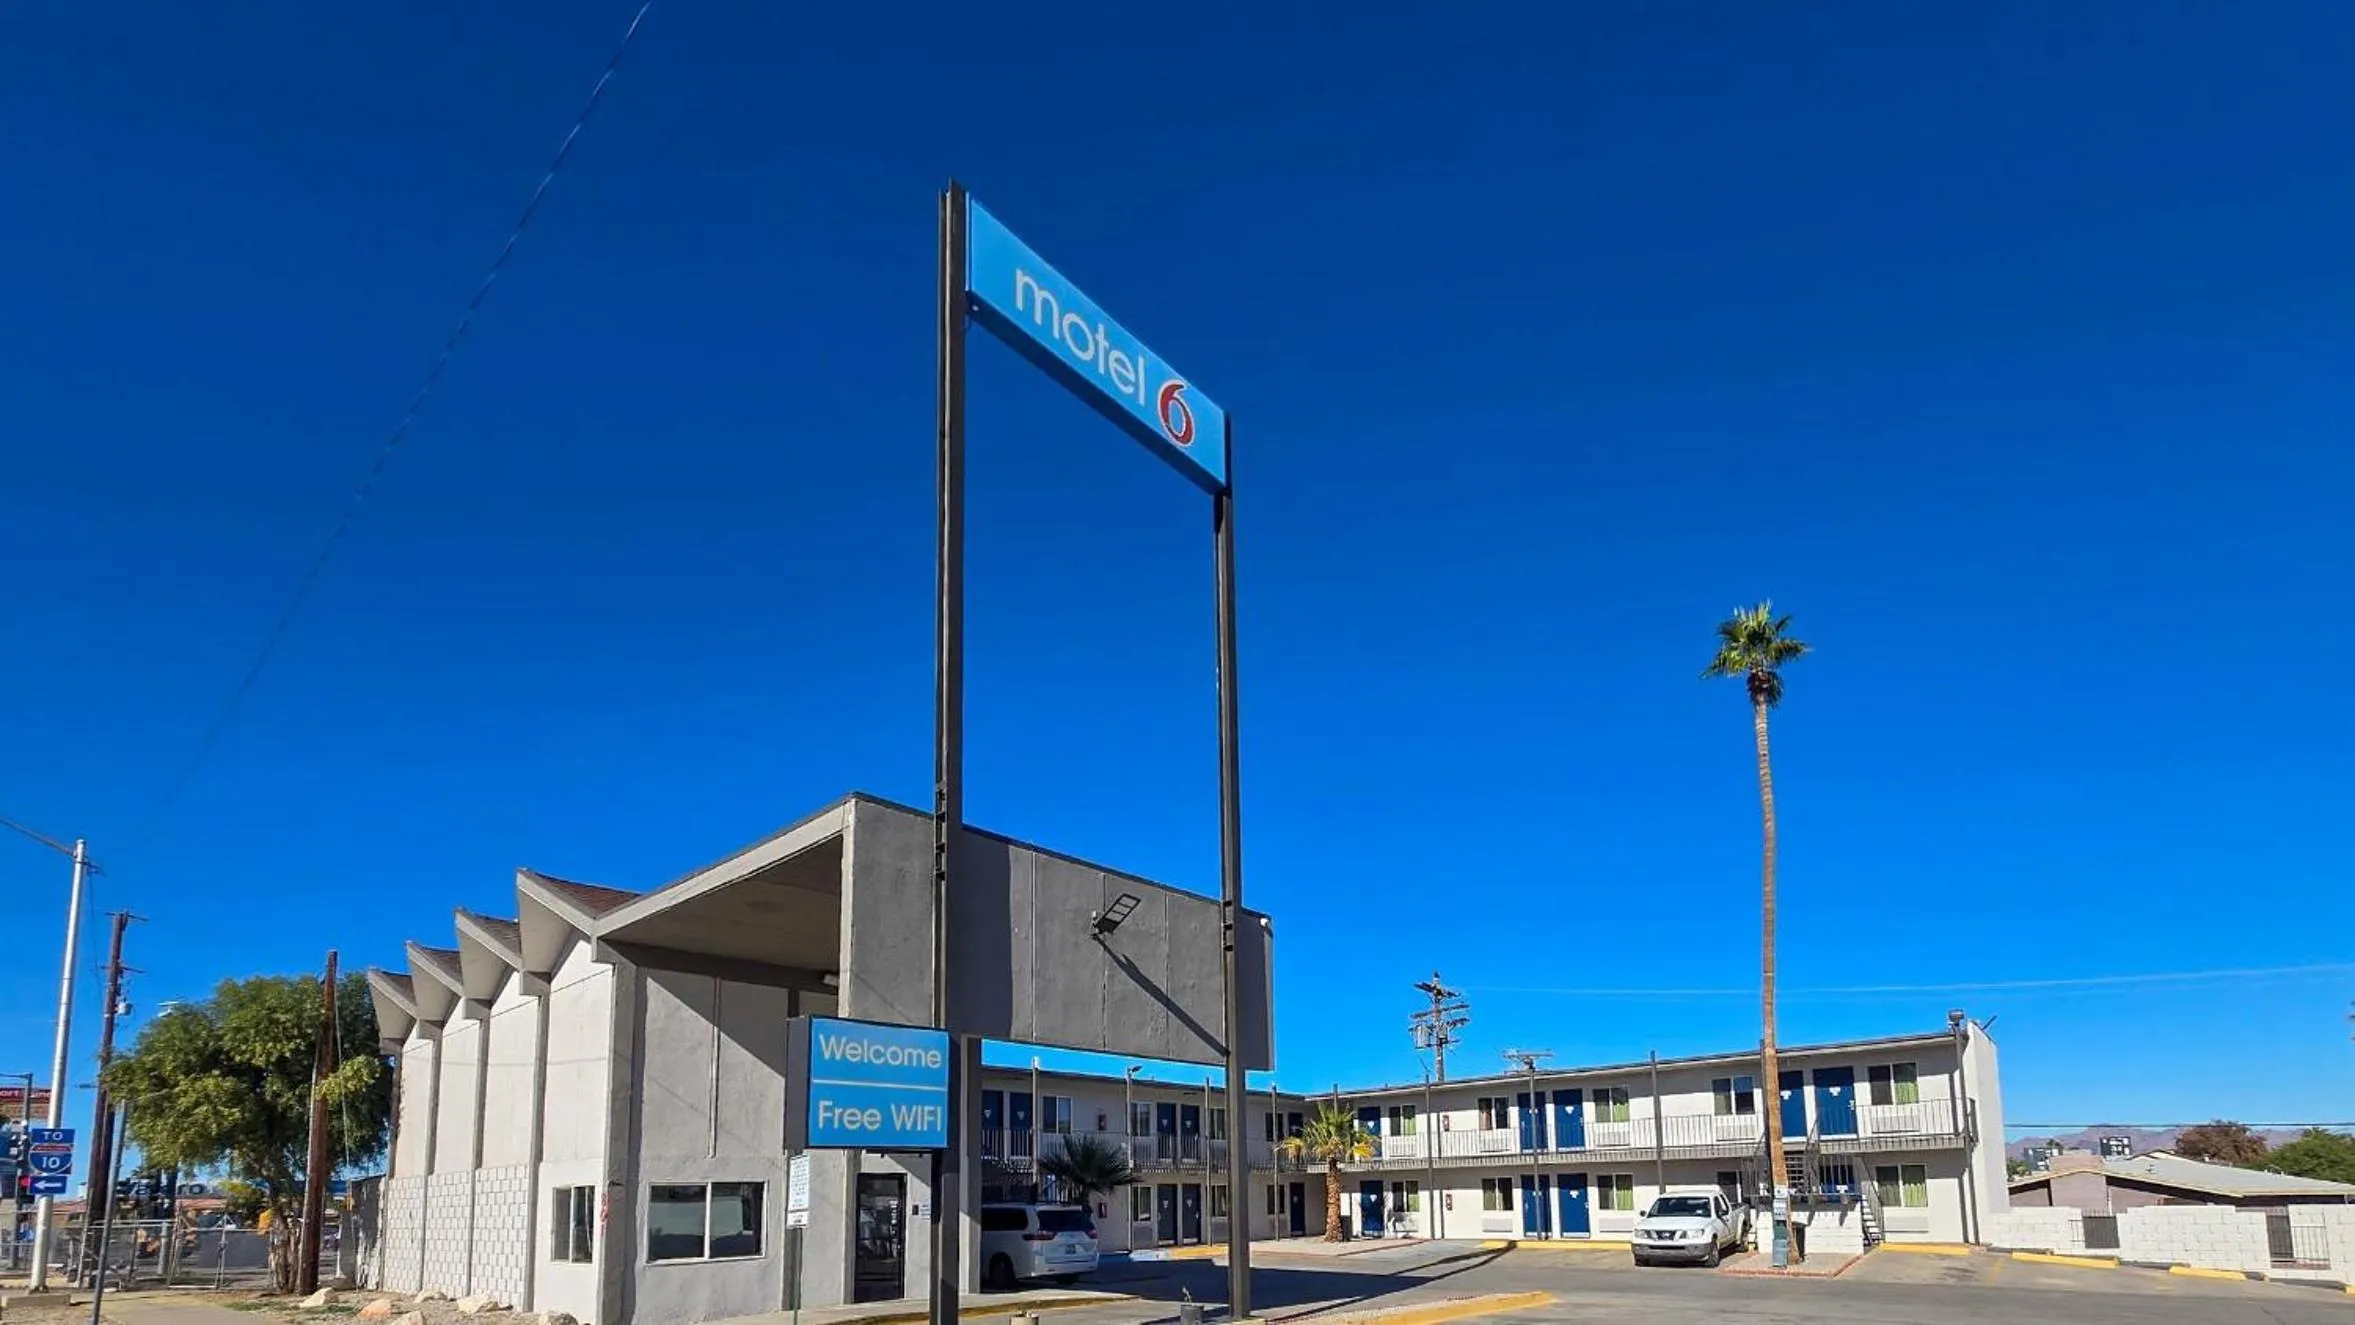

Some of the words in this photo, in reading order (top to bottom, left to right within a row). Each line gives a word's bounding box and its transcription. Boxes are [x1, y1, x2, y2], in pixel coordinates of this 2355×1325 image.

[1015, 267, 1145, 407] motel
[1157, 379, 1196, 447] 6
[819, 1033, 941, 1069] Welcome
[818, 1100, 881, 1131] Free
[890, 1103, 941, 1132] WIFI
[42, 1131, 64, 1141] TO
[42, 1156, 60, 1169] 10
